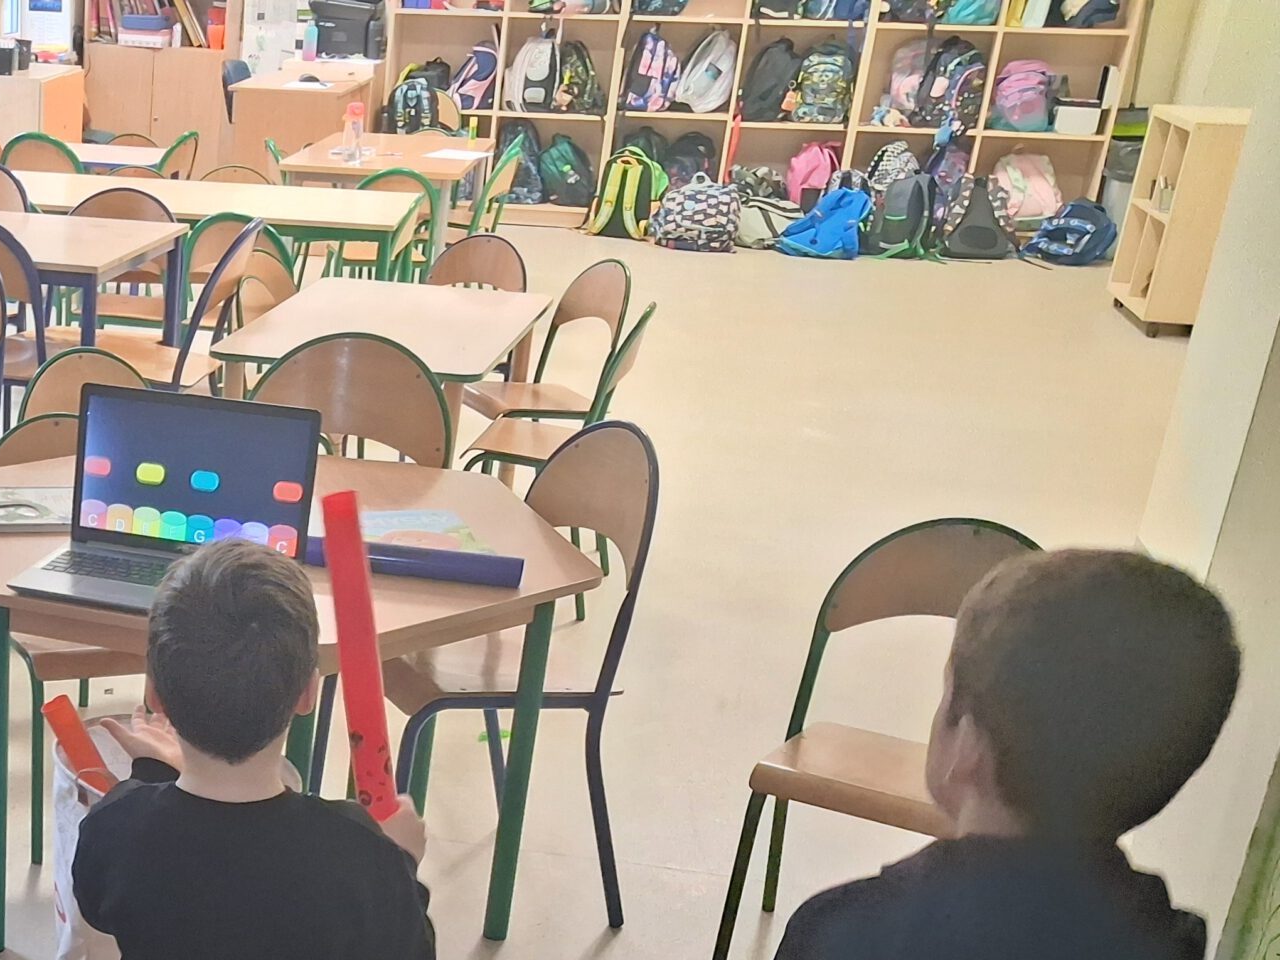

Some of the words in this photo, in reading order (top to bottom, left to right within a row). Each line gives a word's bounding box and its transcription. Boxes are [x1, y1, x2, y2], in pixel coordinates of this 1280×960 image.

[88, 513, 98, 526] C
[194, 529, 206, 543] G
[276, 541, 288, 554] C
